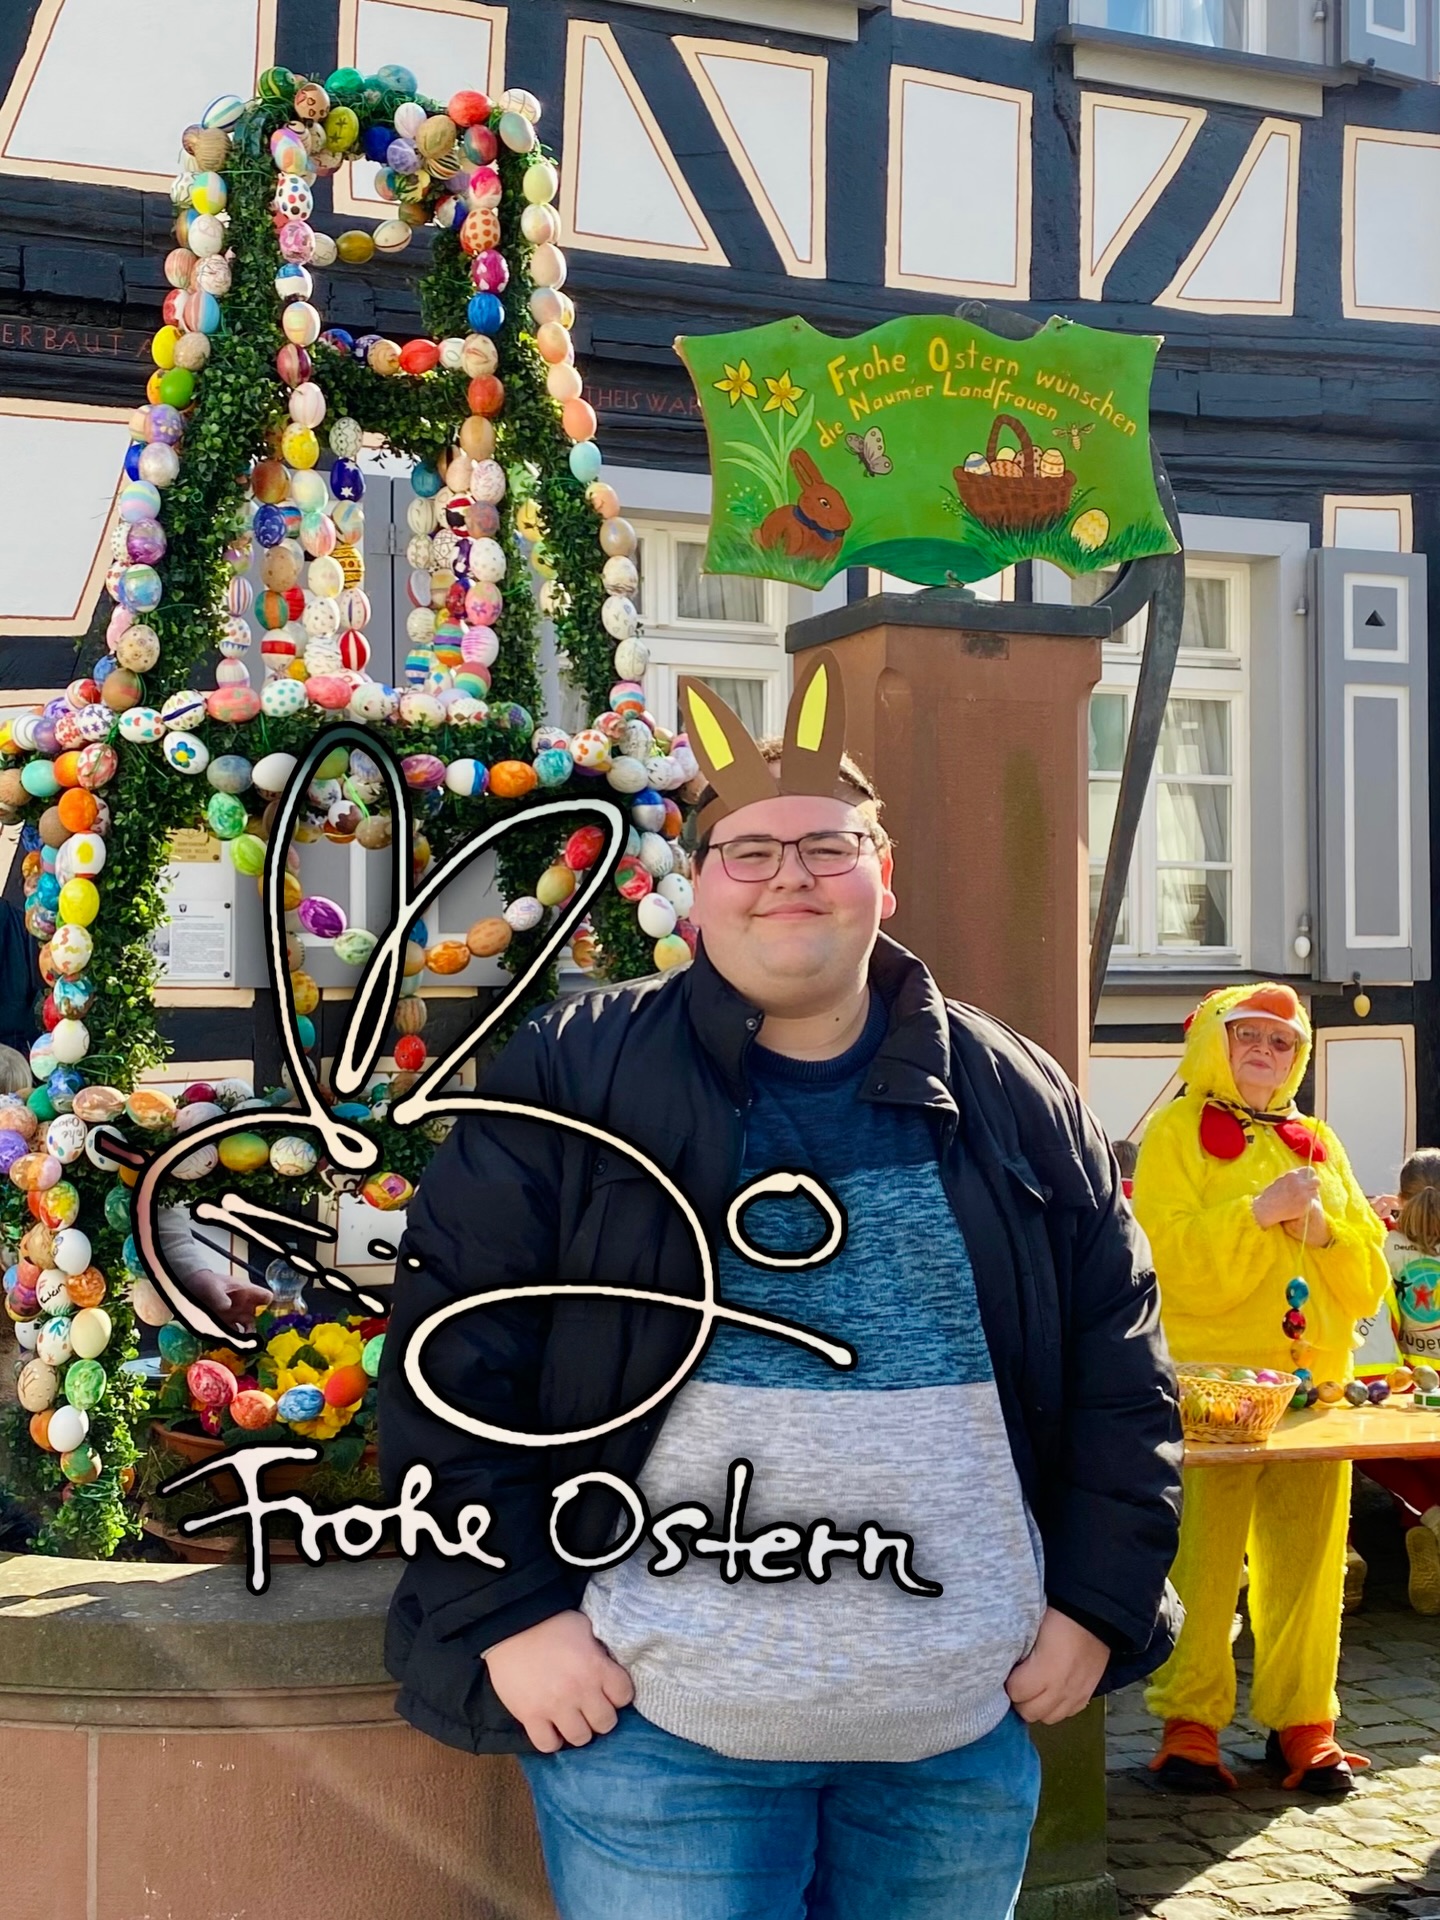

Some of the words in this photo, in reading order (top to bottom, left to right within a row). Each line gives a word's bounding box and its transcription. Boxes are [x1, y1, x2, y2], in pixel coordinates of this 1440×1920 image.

[44, 326, 124, 355] BAUT
[827, 345, 906, 396] Frohe
[928, 337, 1019, 377] Ostern
[816, 420, 844, 448] die
[942, 371, 1058, 421] Landfrauen
[1393, 1243, 1418, 1252] Deut
